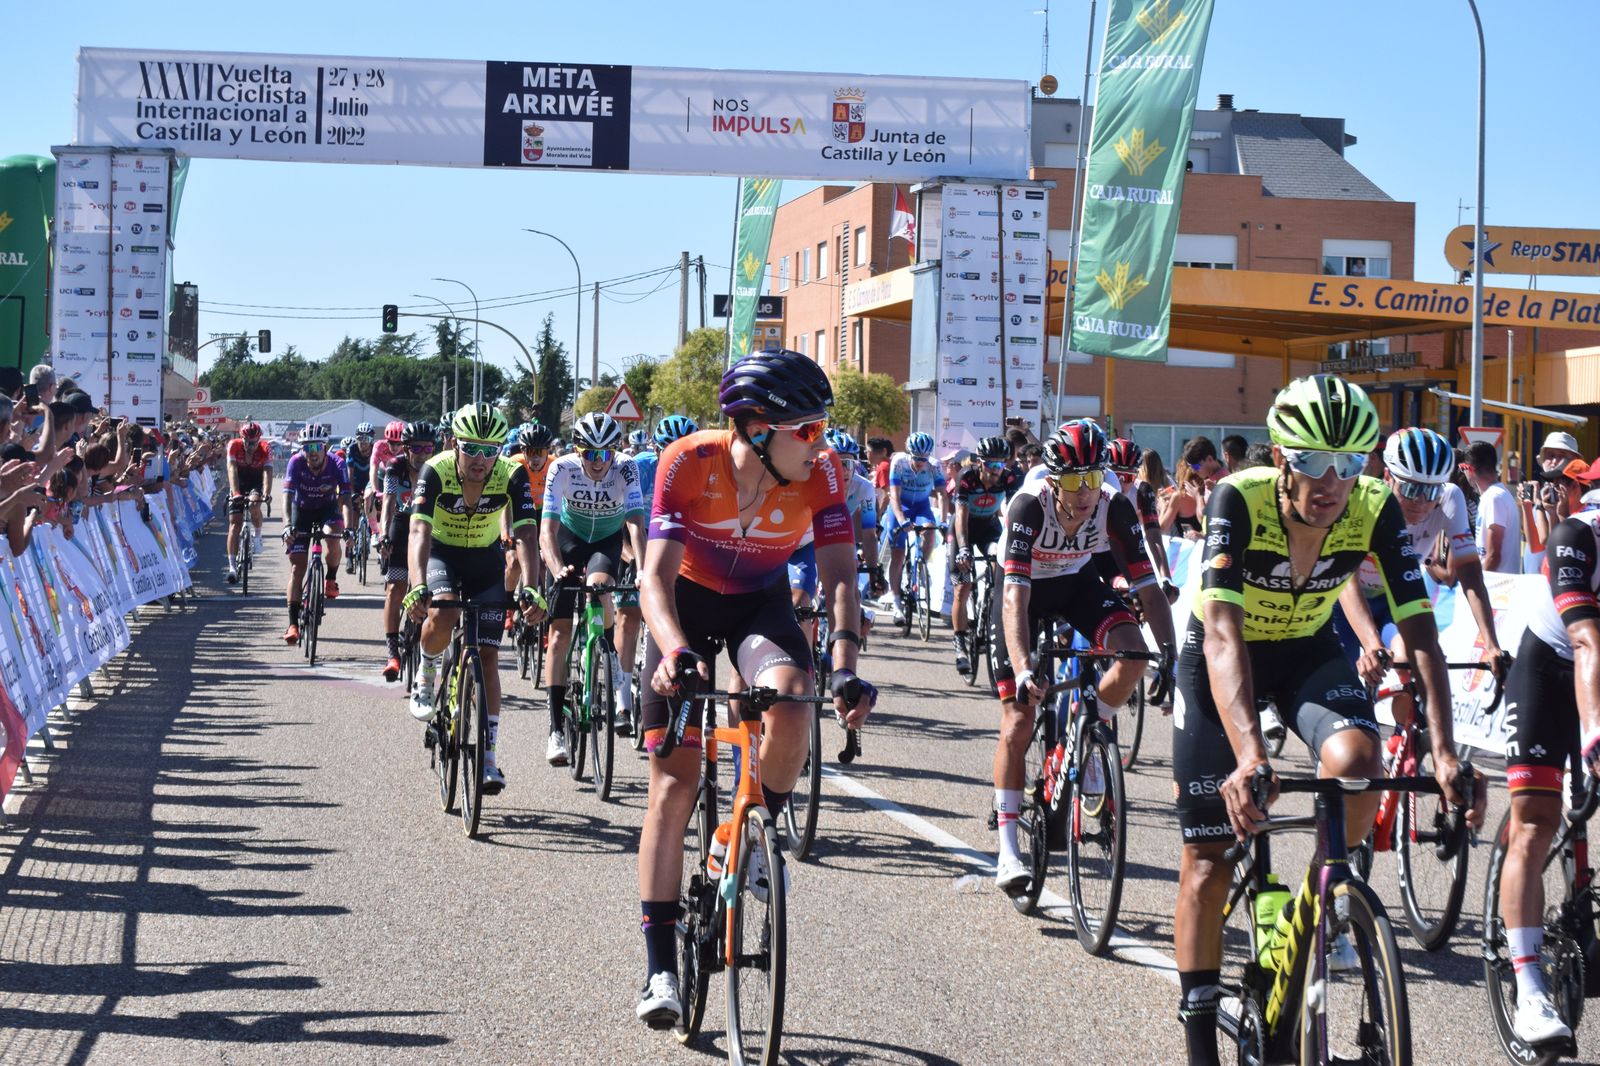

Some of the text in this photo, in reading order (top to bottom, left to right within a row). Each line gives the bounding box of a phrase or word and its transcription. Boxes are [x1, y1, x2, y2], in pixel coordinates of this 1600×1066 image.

[137, 61, 214, 101] XXXVI
[216, 64, 292, 84] Vuelta
[328, 67, 386, 91] 27 y 28
[522, 66, 597, 90] META
[216, 84, 307, 105] Ciclista
[502, 91, 613, 117] ARRIVÉE
[136, 101, 307, 123] Internacional a
[327, 96, 369, 117] Julio
[713, 99, 749, 112] NOS
[136, 122, 307, 146] Castilla y León
[326, 126, 366, 146] 2022
[712, 115, 807, 136] IMPULSA
[869, 128, 946, 145] Junta de
[821, 145, 946, 165] Castilla y León
[1089, 184, 1174, 205] CAJA RURAL
[97, 202, 118, 211] cylv
[1308, 282, 1331, 306] E.
[1339, 283, 1364, 308] S.
[1374, 285, 1470, 315] Camino
[1482, 293, 1511, 318] de
[1517, 295, 1543, 319] la
[1075, 315, 1160, 340] CAJA RURAL
[663, 450, 688, 493] THORNE
[818, 452, 839, 495] Optum
[572, 489, 612, 503] CAJA
[1040, 526, 1100, 552] UAE
[1403, 570, 1422, 582] Q8
[1258, 600, 1291, 612] Q8
